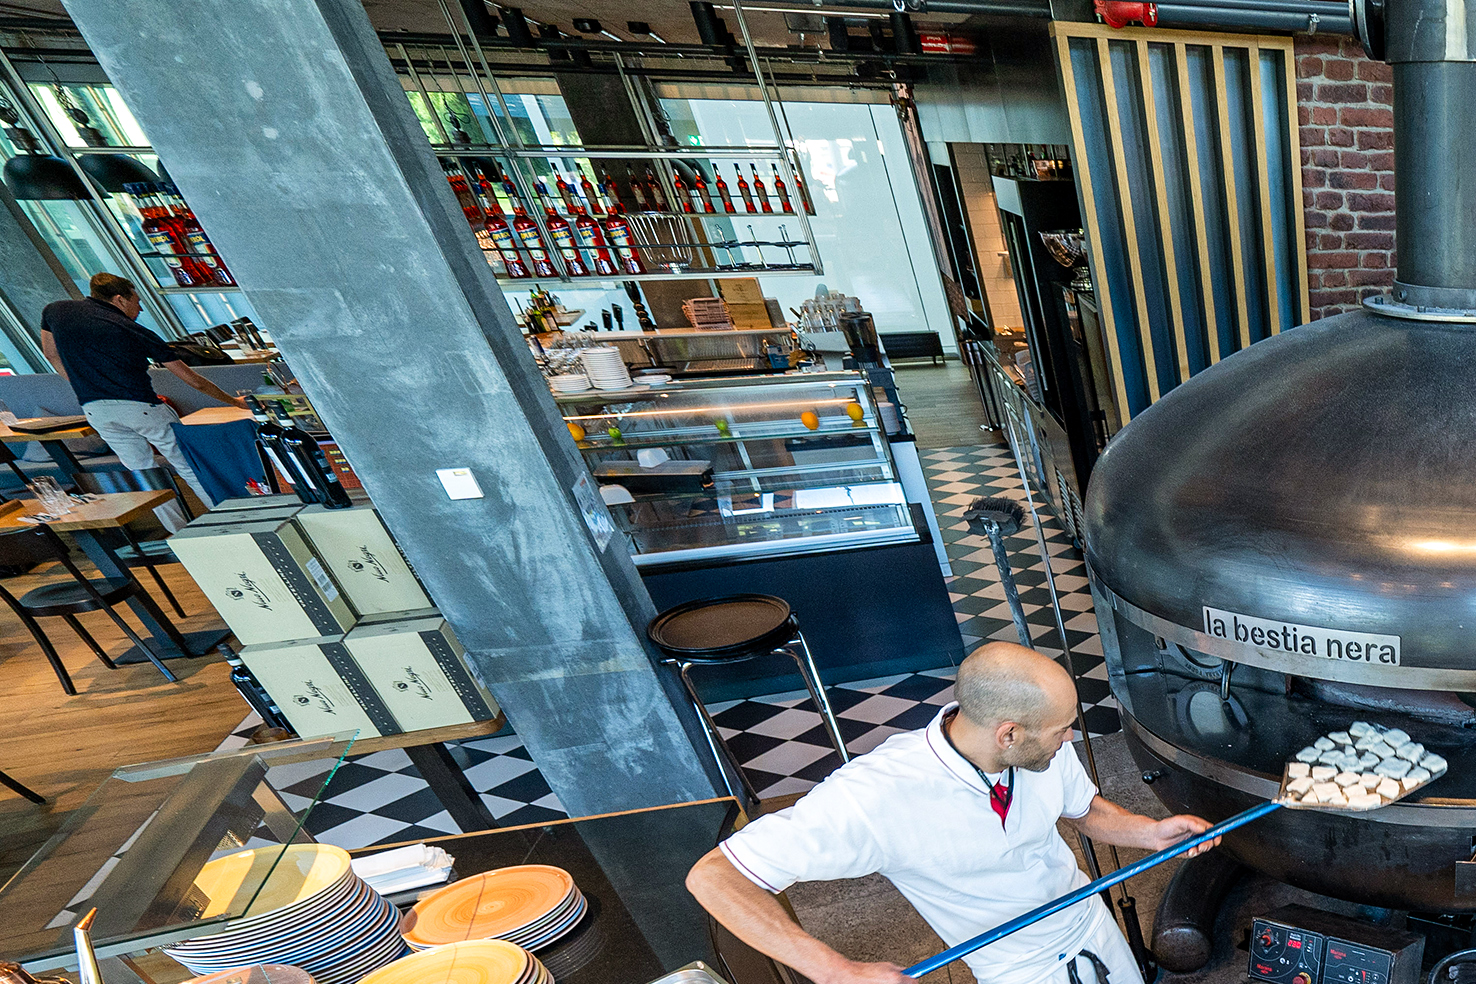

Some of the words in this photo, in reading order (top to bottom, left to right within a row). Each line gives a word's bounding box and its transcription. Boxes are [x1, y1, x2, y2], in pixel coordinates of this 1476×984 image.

[1206, 609, 1227, 638] la
[1233, 616, 1317, 655] bestia
[1326, 638, 1397, 664] nera
